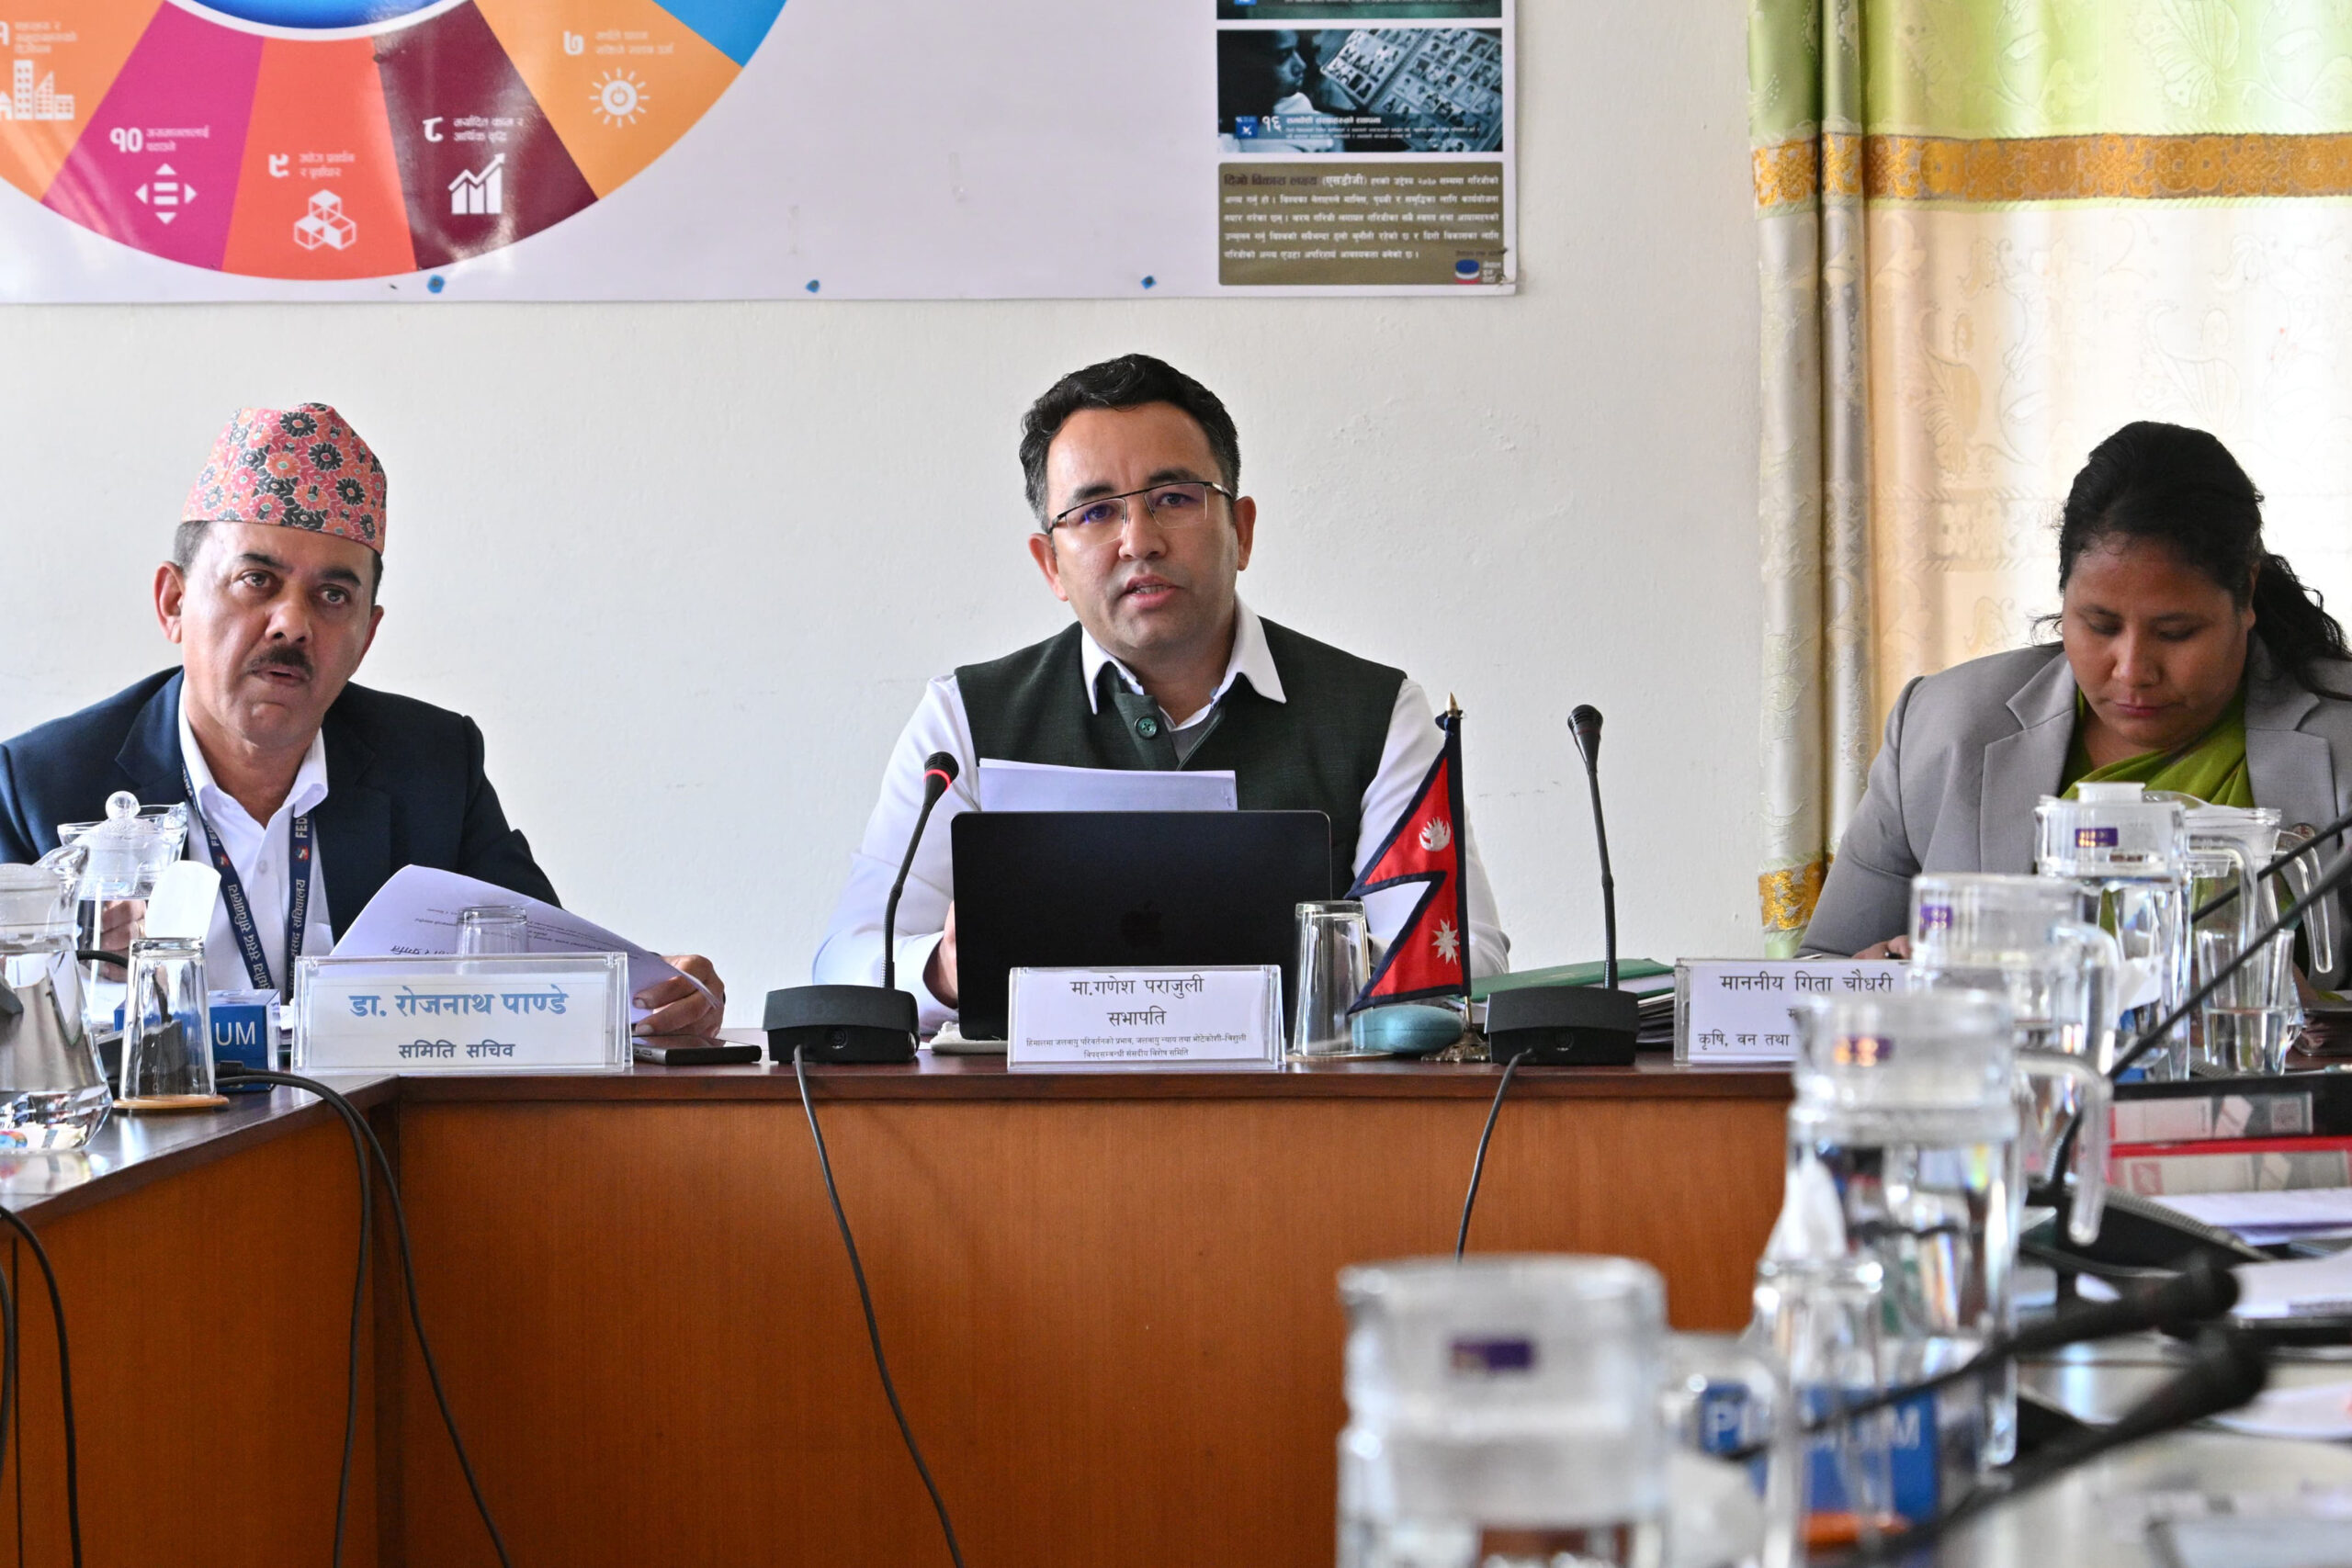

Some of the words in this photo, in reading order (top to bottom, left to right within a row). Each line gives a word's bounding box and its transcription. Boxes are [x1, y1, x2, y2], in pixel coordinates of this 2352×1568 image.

[563, 30, 584, 55] ७
[422, 117, 444, 142] ८
[1261, 116, 1282, 132] १६
[109, 127, 143, 153] १०
[228, 885, 253, 933] सचिवालय
[291, 879, 306, 929] सचिवालय
[243, 934, 261, 962] संसद
[1144, 974, 1205, 999] पराजुली
[1719, 971, 1785, 992] माननीय
[1794, 970, 1834, 992] गिता
[1842, 968, 1894, 993] चौधरी
[348, 995, 388, 1018] डा.
[394, 985, 495, 1018] रोजनाथ
[501, 983, 570, 1015] पाण्डे
[1106, 1005, 1168, 1027] सभापति
[399, 1039, 458, 1059] समिति
[466, 1039, 516, 1059] सचिव
[1026, 1037, 1053, 1047] हिमालमा
[1056, 1038, 1079, 1048] जलवायु
[1080, 1035, 1114, 1046] परिवर्तनको
[1136, 1035, 1159, 1046] जलवायु
[1161, 1035, 1177, 1044] न्याय
[1179, 1035, 1191, 1044] तथा
[1126, 1048, 1148, 1057] संसदीय
[1149, 1047, 1167, 1057] विशेष
[1169, 1046, 1189, 1056] समिति
[1698, 1029, 1728, 1051] कृषि,
[1736, 1033, 1758, 1046] वन
[1764, 1033, 1791, 1047] तथा
